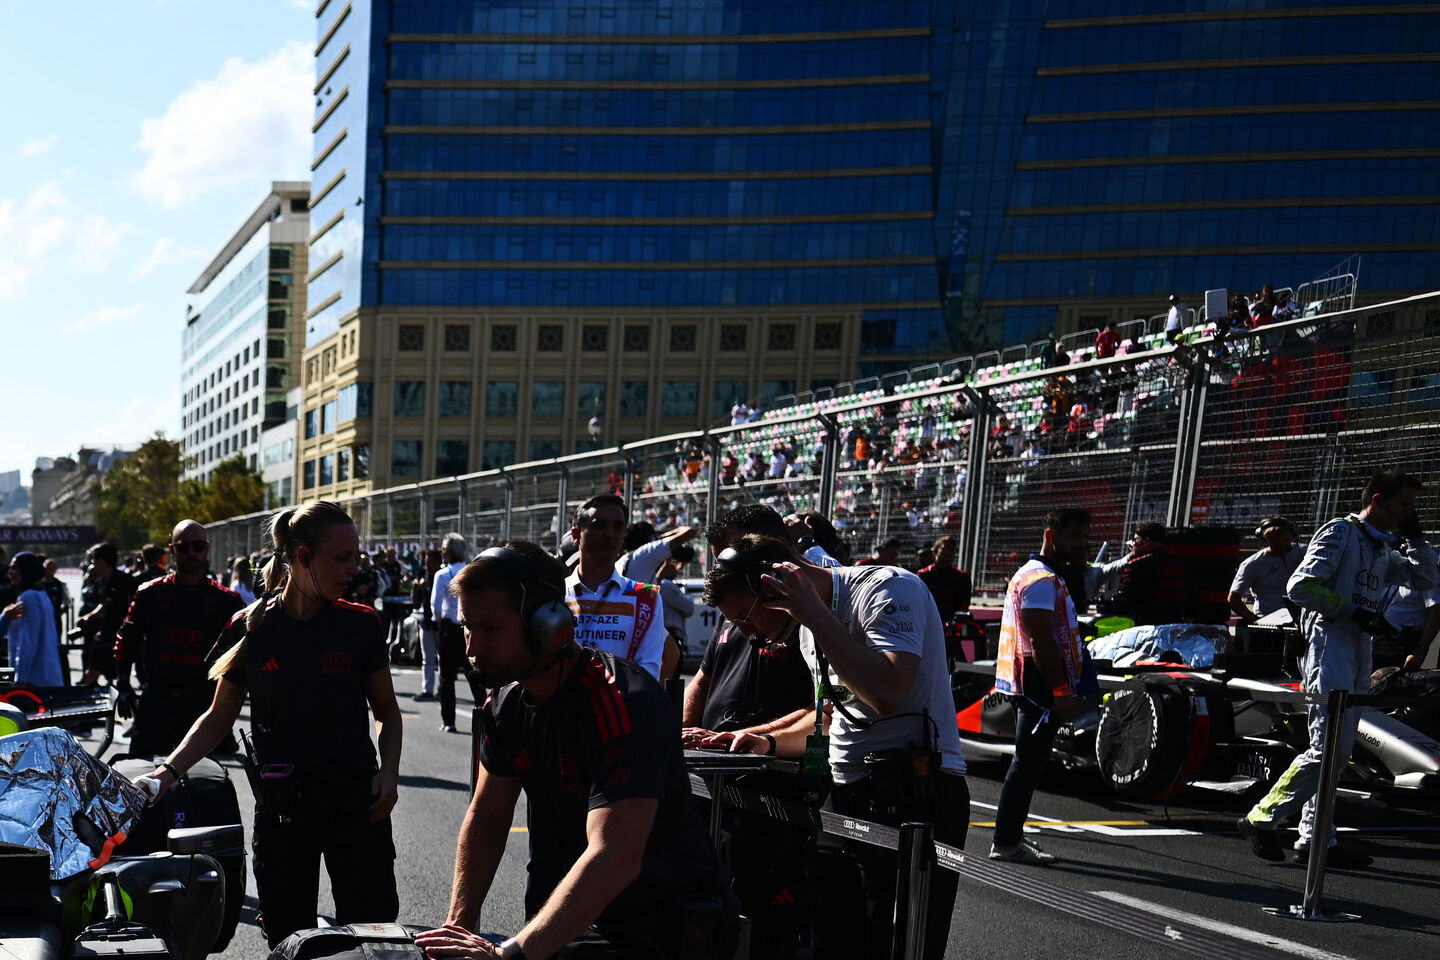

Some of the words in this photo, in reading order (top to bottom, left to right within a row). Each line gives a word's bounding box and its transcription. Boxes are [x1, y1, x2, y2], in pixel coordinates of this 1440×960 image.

[16, 528, 79, 541] AIRWAYS
[700, 610, 716, 627] 11
[576, 630, 626, 641] UTINEER
